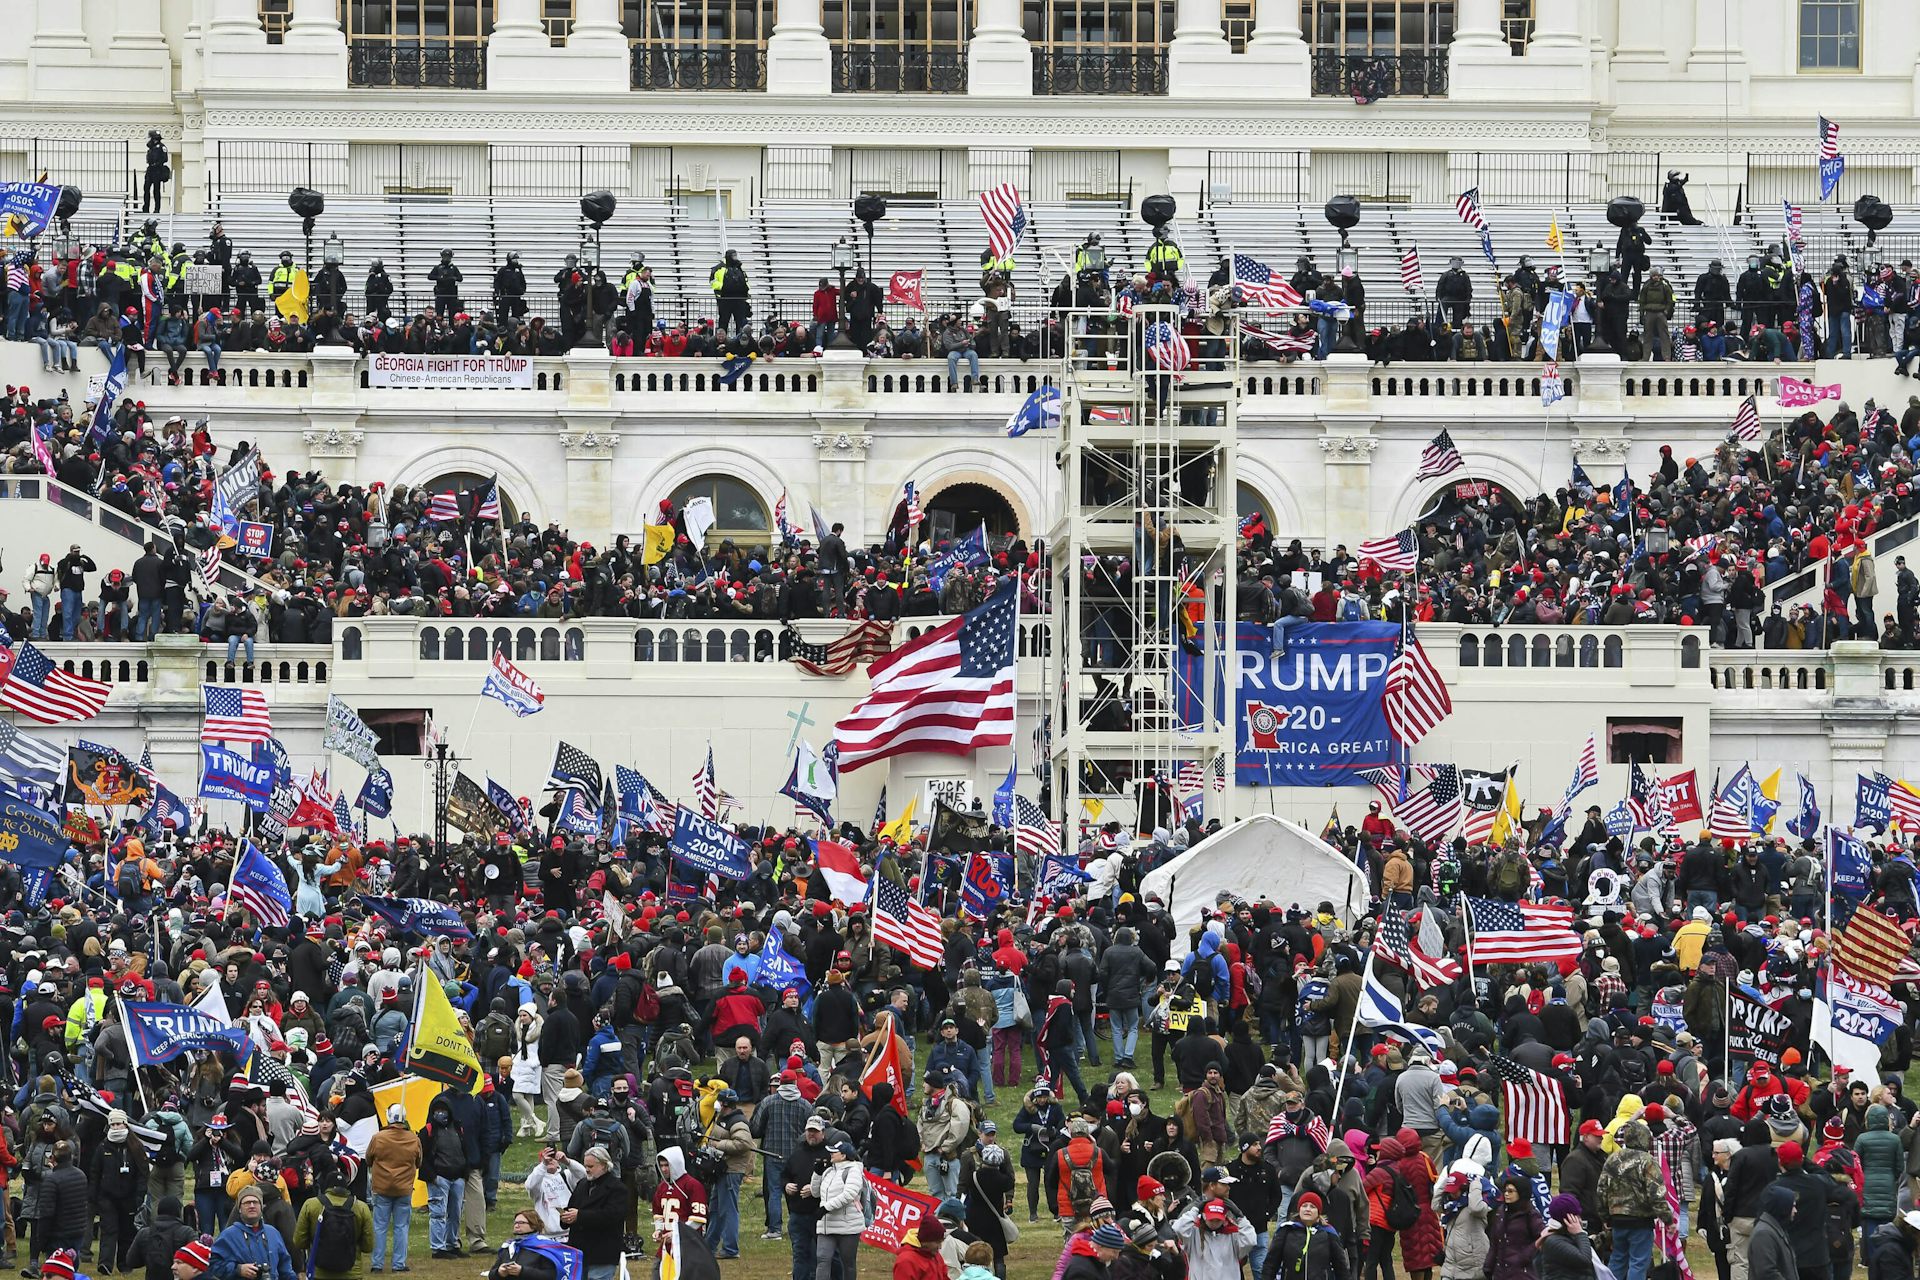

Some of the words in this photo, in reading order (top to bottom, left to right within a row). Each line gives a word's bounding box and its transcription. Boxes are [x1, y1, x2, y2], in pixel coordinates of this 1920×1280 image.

[375, 358, 424, 372] GEORGIA
[428, 359, 461, 372] FIGHT
[463, 360, 487, 372] FOR
[490, 360, 528, 373] TRUMP
[390, 373, 460, 384] Chinese-American
[463, 374, 512, 384] Republicans
[247, 528, 265, 538] STOP
[248, 537, 262, 546] THE
[240, 545, 267, 556] STEAL
[1325, 738, 1389, 758] GREAT!
[208, 752, 271, 785] TRUMP
[929, 780, 966, 793] FUCK
[366, 798, 385, 813] GREAT!
[676, 805, 746, 855] TRUMP
[686, 838, 730, 862] -2020-
[684, 851, 717, 868] AMERICA
[717, 863, 745, 879] GREAT!
[249, 870, 269, 885] KEEP
[1834, 871, 1855, 885] KEEP
[436, 918, 464, 929] GREAT!
[1836, 1008, 1882, 1040] 2021
[151, 1034, 171, 1056] KEEP
[168, 1032, 207, 1045] AMERICA
[436, 1036, 462, 1053] DONT
[1729, 1035, 1745, 1049] FUCK
[690, 1201, 707, 1215] 36
